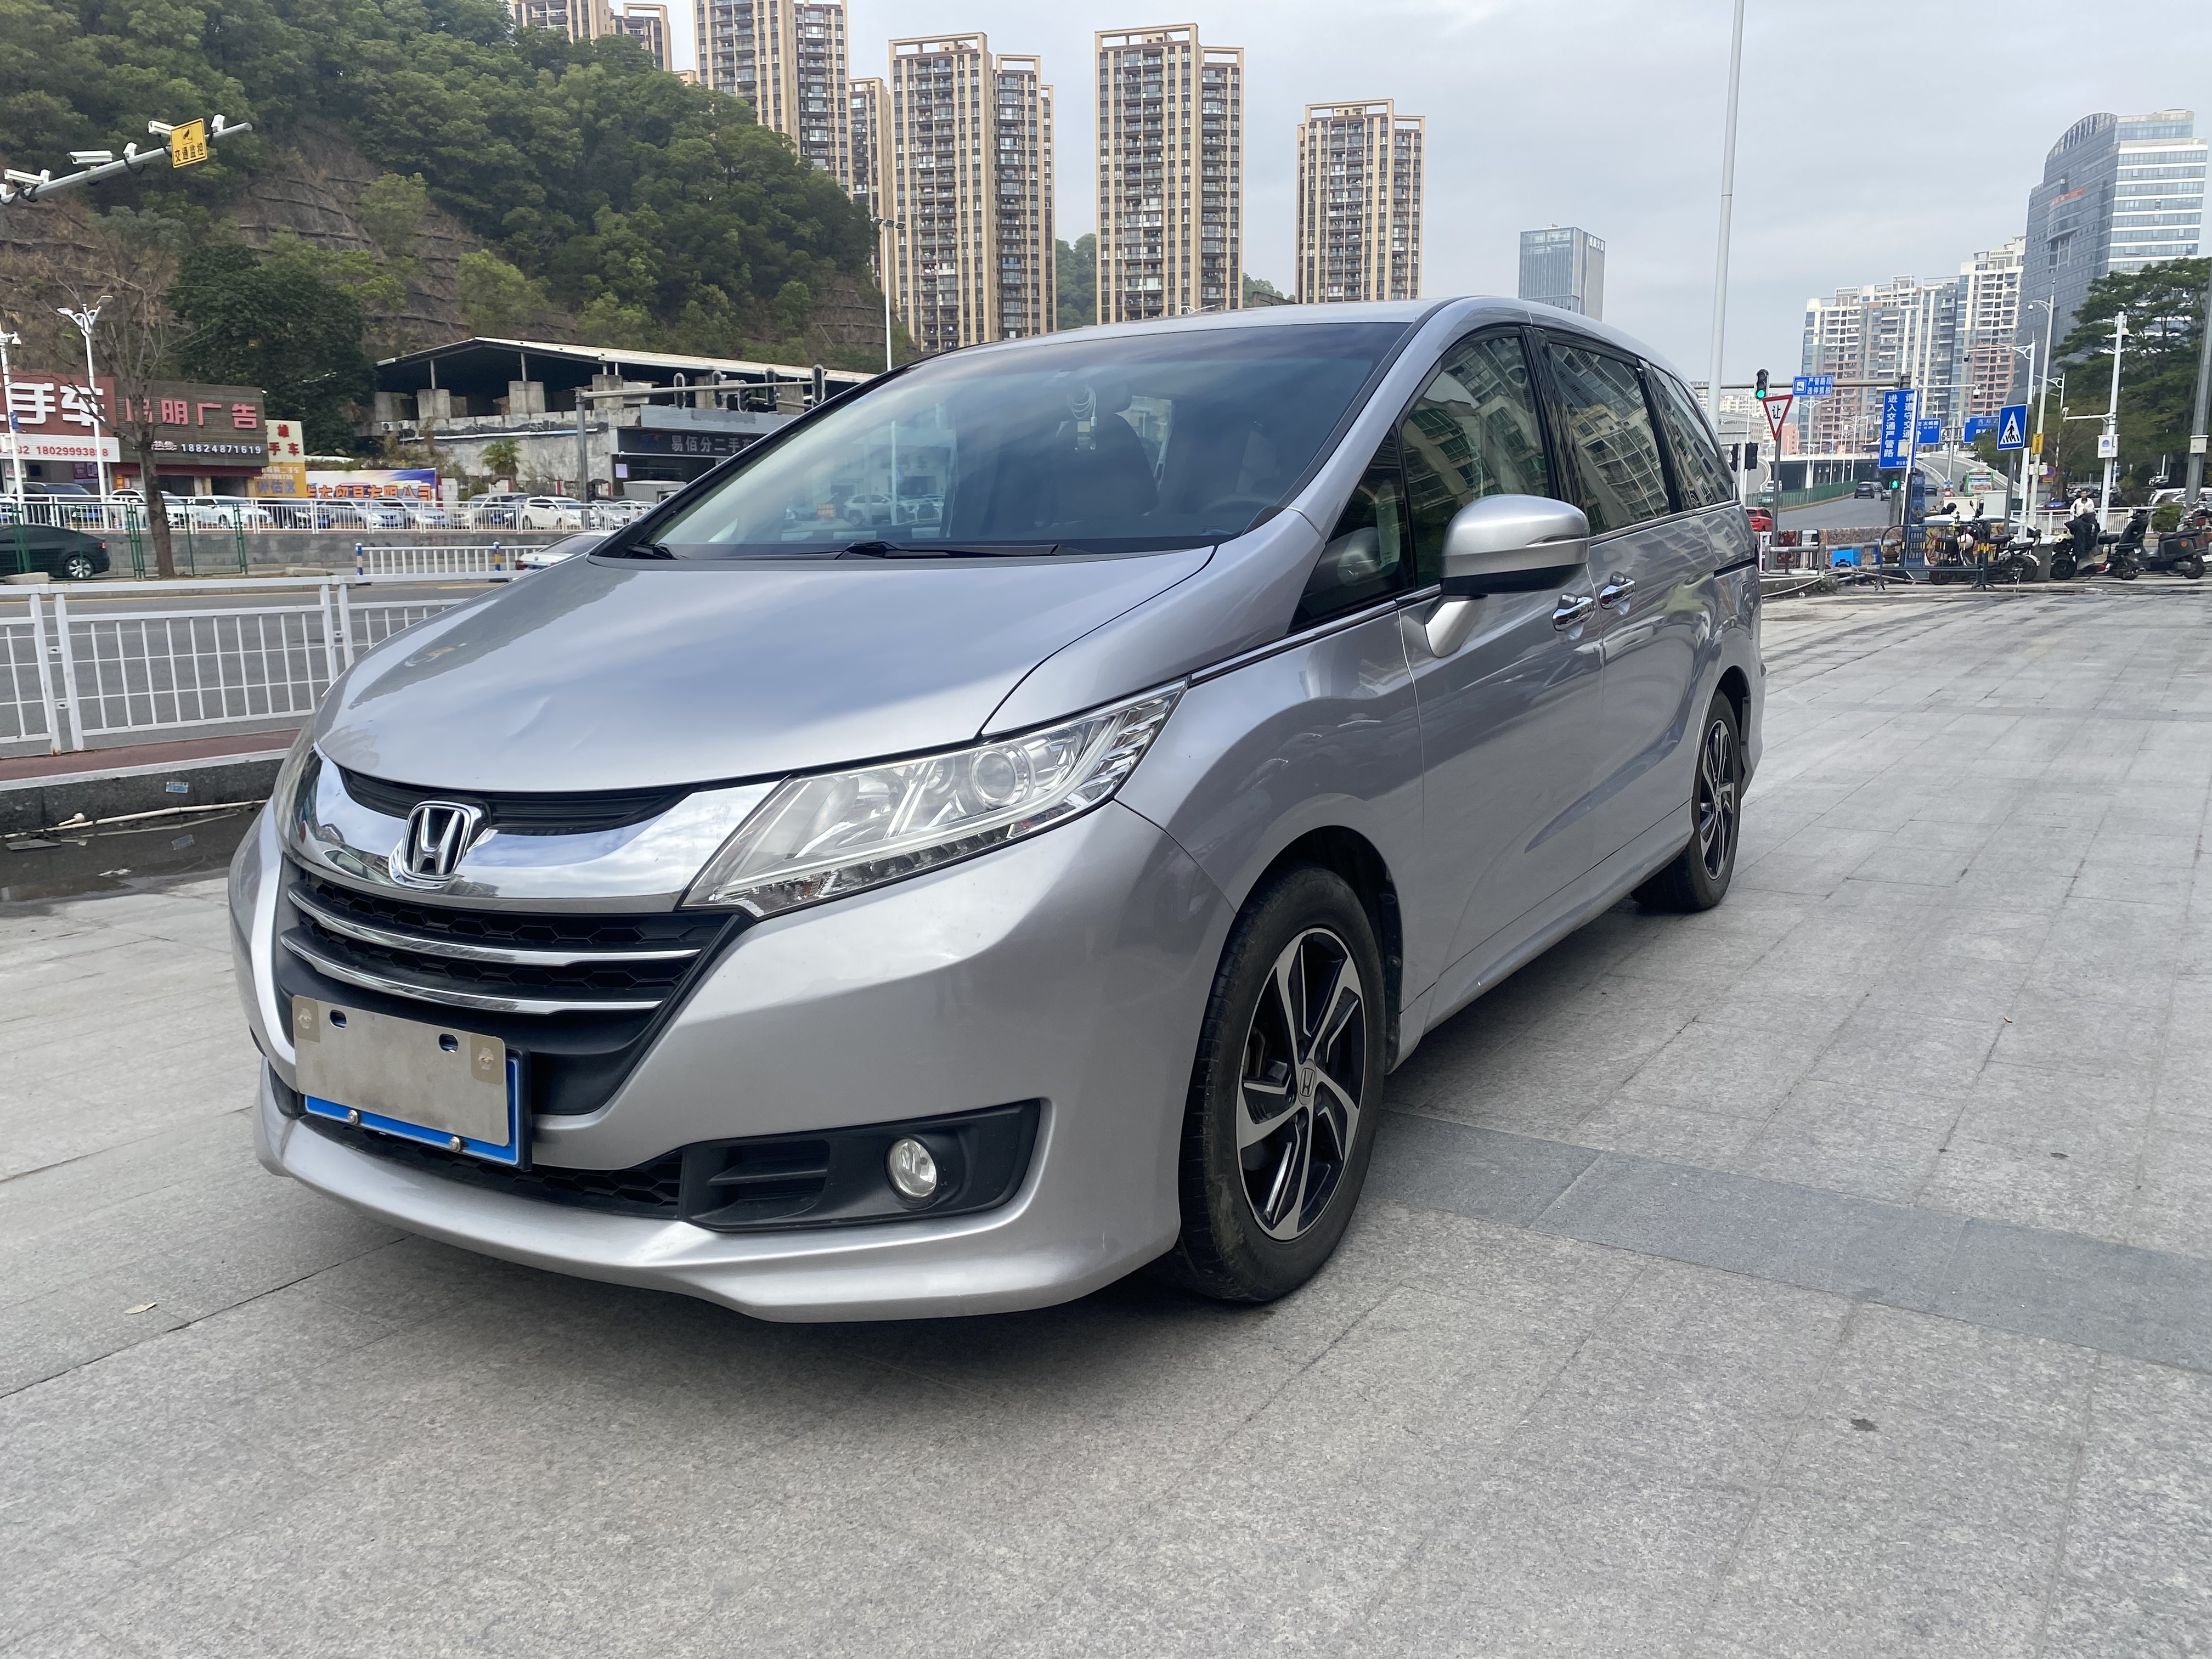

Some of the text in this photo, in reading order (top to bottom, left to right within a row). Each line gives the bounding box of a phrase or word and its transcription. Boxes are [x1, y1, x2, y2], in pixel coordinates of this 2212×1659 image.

[174, 142, 204, 162] 交通监控
[1808, 376, 1832, 385] 严管路段
[0, 382, 105, 426] 手车
[1772, 404, 1781, 419] 让
[1902, 393, 1915, 441] 请遵守交通
[1883, 394, 1898, 458] 进入交通严管路
[36, 445, 109, 456] 1802999388
[181, 443, 261, 454] 18824871619
